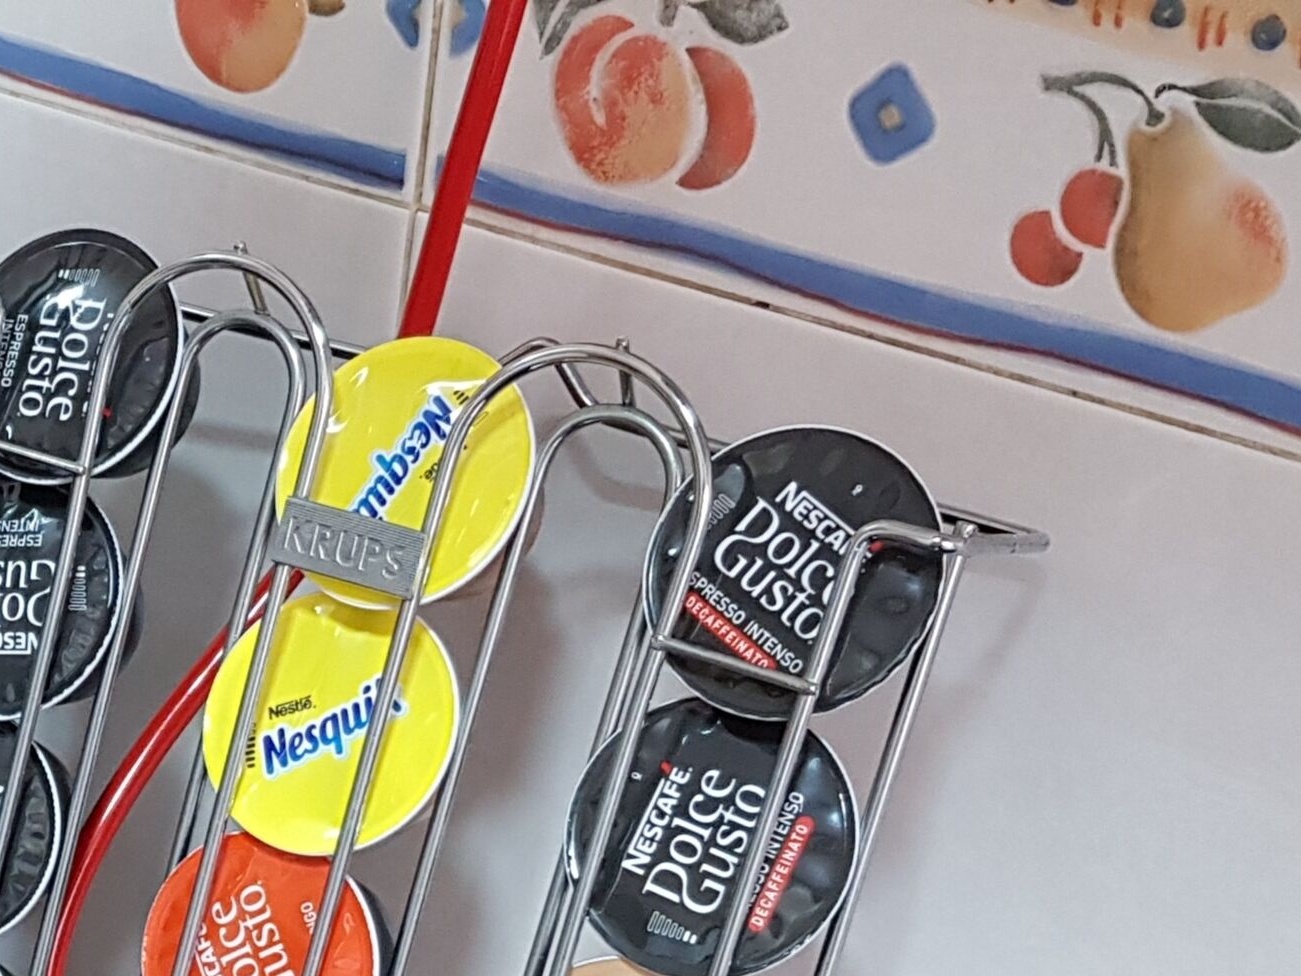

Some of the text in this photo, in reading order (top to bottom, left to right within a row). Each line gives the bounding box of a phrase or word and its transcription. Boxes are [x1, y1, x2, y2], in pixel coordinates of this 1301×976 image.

[1, 313, 29, 388] ESPRESSO
[352, 394, 454, 520] Nesqui
[283, 516, 403, 580] KRUPS
[734, 495, 836, 606] Dolc
[688, 571, 803, 675] SPRESSO INTENSO
[263, 677, 402, 775] Nesqui
[641, 768, 736, 903] Dolce
[684, 784, 767, 914] Gusto
[752, 824, 809, 927] DECAFFEINATO
